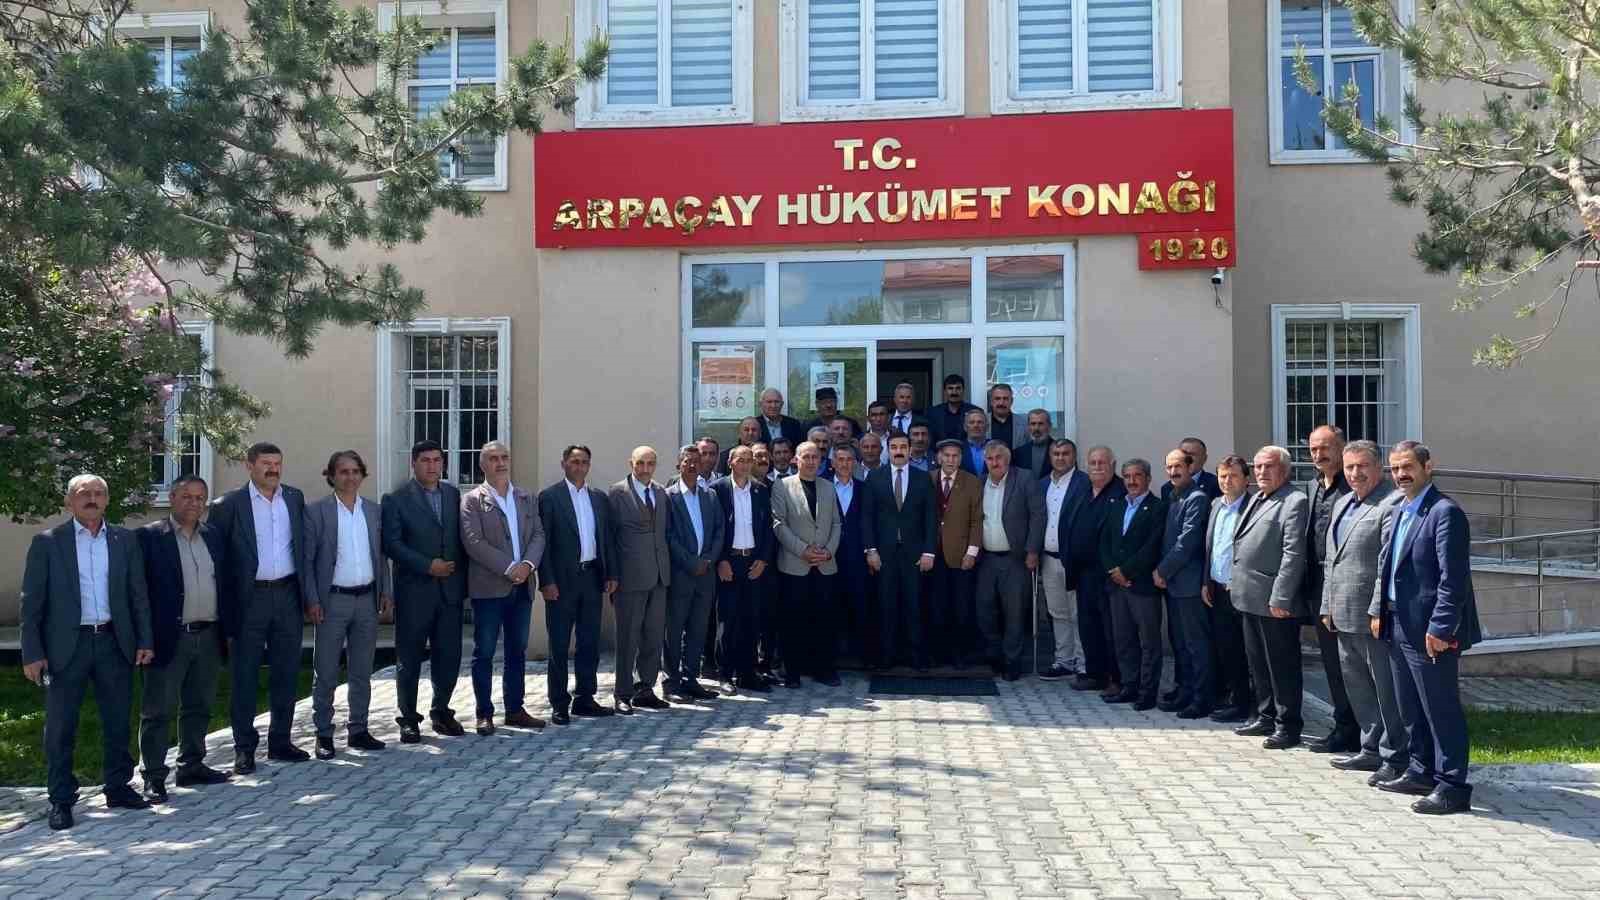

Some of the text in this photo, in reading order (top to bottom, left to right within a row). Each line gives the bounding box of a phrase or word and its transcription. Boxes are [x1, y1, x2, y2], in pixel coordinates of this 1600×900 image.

[834, 137, 917, 170] T.C.
[553, 170, 1217, 235] ARPAÇAY HÜKÜMET KONAĞI
[1151, 236, 1229, 261] 1920
